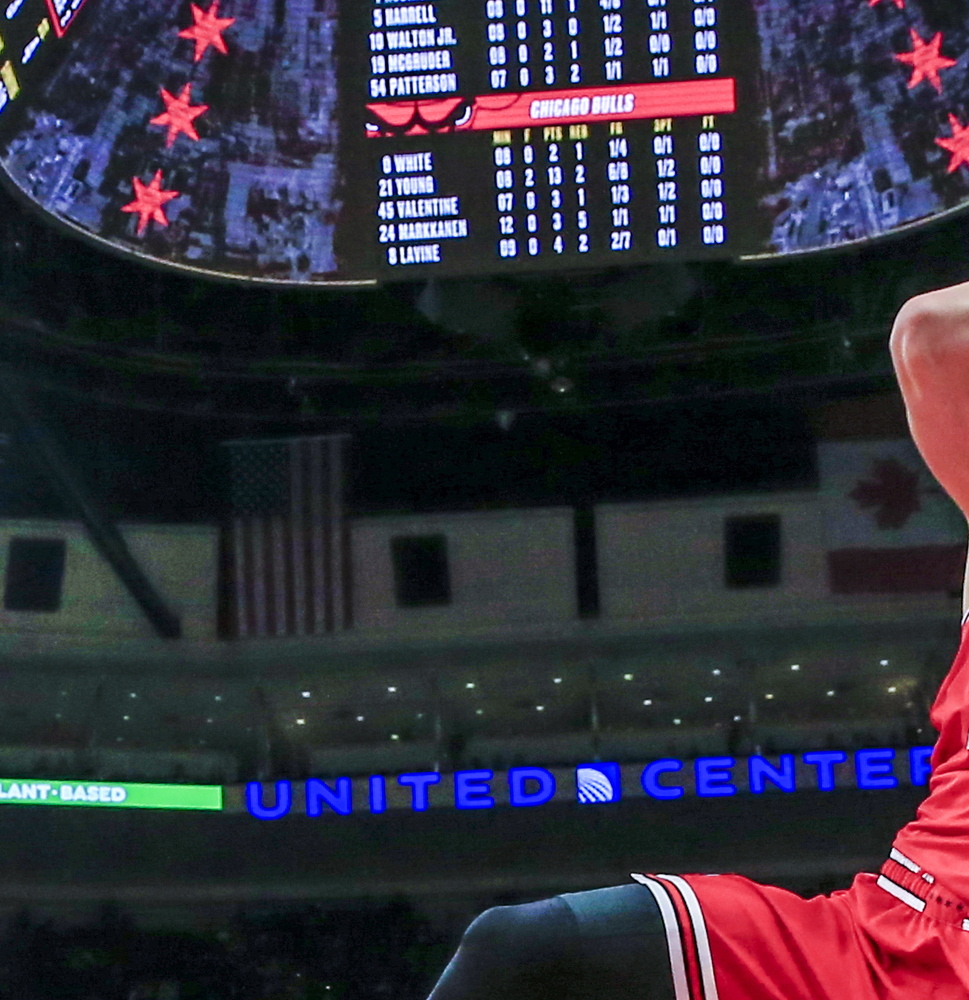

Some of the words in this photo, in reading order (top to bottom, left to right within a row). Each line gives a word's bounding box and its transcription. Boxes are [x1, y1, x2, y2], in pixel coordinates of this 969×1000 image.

[386, 28, 436, 50] WALTON
[602, 12, 622, 34] 1/2
[650, 10, 667, 30] 1/1
[544, 42, 554, 62] 2
[604, 36, 624, 57] 1/2
[389, 73, 457, 96] PATTERSON
[570, 63, 580, 84] 2
[605, 60, 622, 80] 1/1
[652, 56, 669, 77] 1/1
[530, 96, 590, 119] CHICAGO
[591, 93, 636, 115] BULLS
[394, 152, 432, 174] WHITE
[548, 142, 559, 162] 2
[575, 141, 582, 161] 1
[378, 178, 393, 198] 21
[394, 175, 434, 196] YOUNG
[524, 168, 535, 188] 2
[574, 164, 586, 184] 2
[656, 158, 676, 178] 1/2
[378, 201, 394, 220] 45
[396, 196, 458, 218] VALENTINE
[551, 188, 561, 208] 3
[578, 188, 585, 207] 1
[658, 182, 676, 202] 1/2
[378, 224, 396, 243] 24
[499, 215, 514, 234] 12
[552, 212, 562, 232] 3
[612, 207, 628, 227] 1/1
[658, 204, 676, 224] 1/1
[399, 244, 440, 264] LAVINE
[554, 235, 563, 254] 4
[578, 233, 589, 252] 2
[610, 230, 632, 250] 2/7
[246, 766, 557, 821] UNITED
